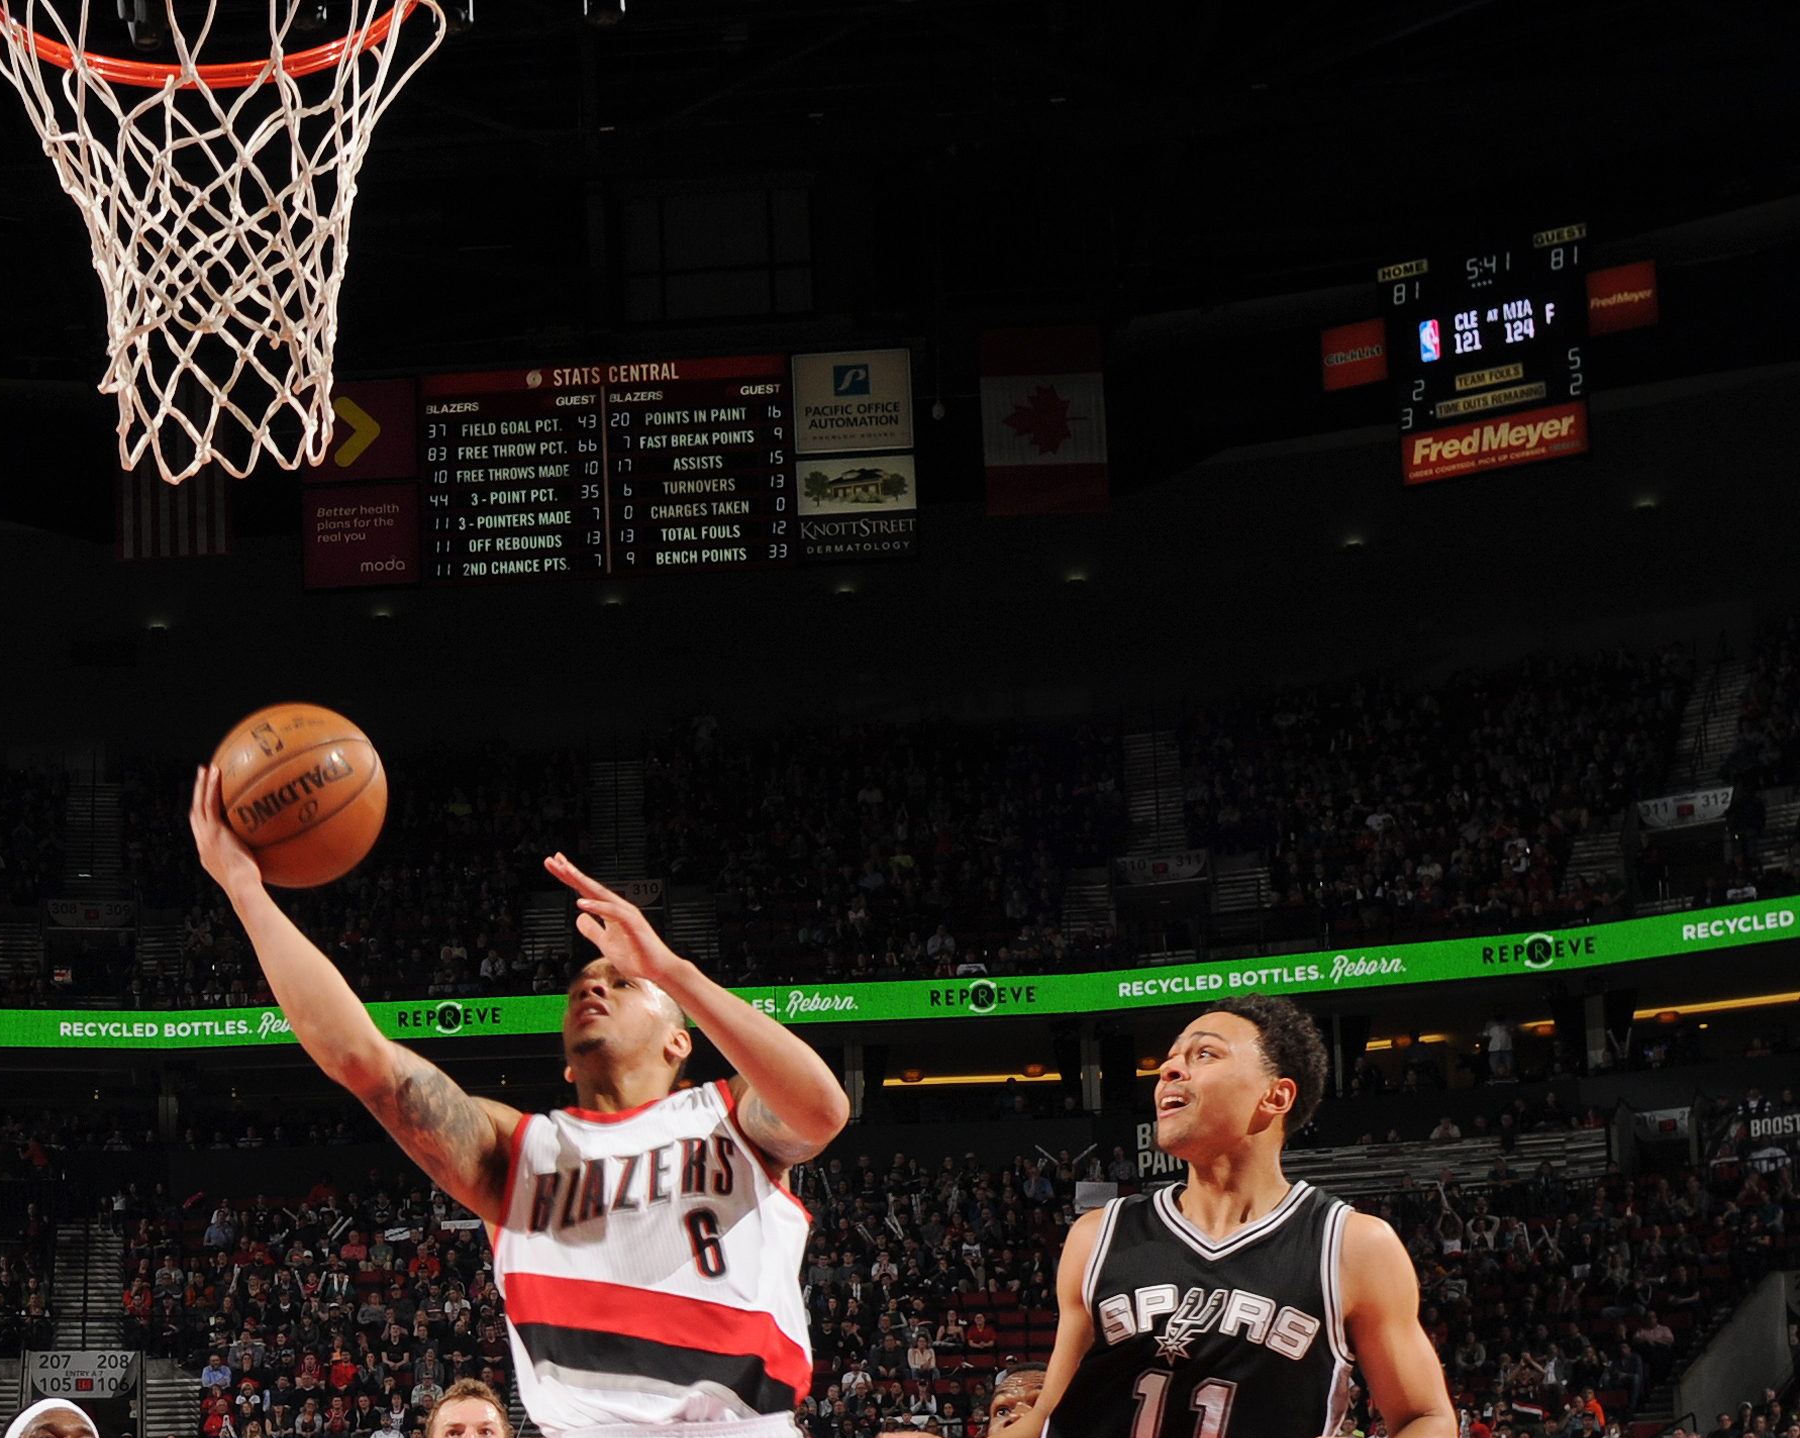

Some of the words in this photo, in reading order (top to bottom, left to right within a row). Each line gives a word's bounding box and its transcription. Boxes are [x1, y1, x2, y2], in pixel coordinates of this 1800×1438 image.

[1536, 226, 1586, 245] GUEST
[1381, 261, 1426, 280] HOME
[1393, 281, 1420, 305] 81
[1466, 253, 1510, 280] 5:41
[1551, 246, 1578, 270] 81
[1454, 310, 1478, 331] CLE
[1486, 308, 1499, 323] AT
[1503, 299, 1533, 320] MIA
[1545, 302, 1555, 325] F
[1454, 329, 1482, 354] 121
[1504, 318, 1535, 344] 124
[553, 366, 600, 387] STATS
[608, 362, 679, 383] CENTRAL
[1457, 373, 1486, 387] TEAM
[1488, 366, 1521, 381] FOULS
[609, 390, 663, 403] BLAZERS
[740, 384, 781, 396] GUEST
[1437, 402, 1461, 416] TIME
[1463, 397, 1489, 411] OUTS
[1491, 385, 1545, 406] REMAINING
[425, 402, 479, 414] BLAZERS
[555, 394, 595, 406] GUEST
[805, 404, 852, 417] PACIFIC
[857, 402, 900, 414] OFFICE
[645, 410, 690, 426] POINTS
[694, 409, 707, 423] IN
[711, 407, 747, 422] PAINT
[808, 414, 899, 430] AUTOMATION
[461, 423, 497, 437] FIELD
[500, 420, 532, 435] GOAL
[535, 419, 563, 432] PCT.
[639, 435, 667, 449] FAST
[671, 432, 709, 447] BREAK
[712, 430, 754, 445] POINTS
[458, 445, 490, 460] FREE
[492, 443, 536, 459] THROW
[539, 441, 568, 456] PCT.
[673, 455, 723, 470] ASSISTS
[456, 469, 485, 483] FREE
[487, 466, 536, 481] THROWS
[538, 464, 570, 478] MADE
[663, 478, 736, 494] TURNOVERS
[490, 490, 527, 505] POINT
[530, 488, 558, 502] PCT.
[316, 507, 357, 518] Better
[360, 503, 399, 515] health
[651, 503, 708, 520] CHARGES
[711, 500, 750, 515] TAKEN
[317, 519, 350, 532] plans
[353, 517, 370, 528] for
[373, 516, 394, 527] the
[477, 512, 536, 529] POINTERS
[538, 511, 571, 525] MADE
[317, 532, 341, 543] real
[344, 532, 366, 543] you
[661, 526, 698, 541] TOTAL
[701, 524, 741, 540] FOULS
[468, 539, 492, 552] OFF
[496, 535, 563, 551] REBOUNDS
[806, 540, 911, 555] DERMATOLOGY
[360, 558, 406, 573] moda
[656, 550, 698, 565] BENCH
[702, 547, 747, 563] POINTS
[463, 562, 487, 576] 2ND
[491, 559, 540, 575] CHANCE
[543, 558, 571, 572] PTS.
[633, 883, 659, 895] 310
[1683, 910, 1796, 942] RECYCLED
[1118, 972, 1223, 998] RECYCLED
[1229, 965, 1325, 989] BOTTLES.
[1329, 955, 1406, 984] Reborn.
[786, 990, 859, 1017] Reborn.
[59, 1021, 158, 1038] RECYCLED
[163, 1019, 253, 1037] BOTTLES.
[528, 1133, 735, 1238] BLAZERS
[684, 1206, 728, 1282] 6
[1099, 1284, 1320, 1362] SPURS
[39, 1355, 71, 1369] 207
[97, 1355, 129, 1369] 208
[40, 1377, 72, 1392] 105
[98, 1377, 130, 1392] 106
